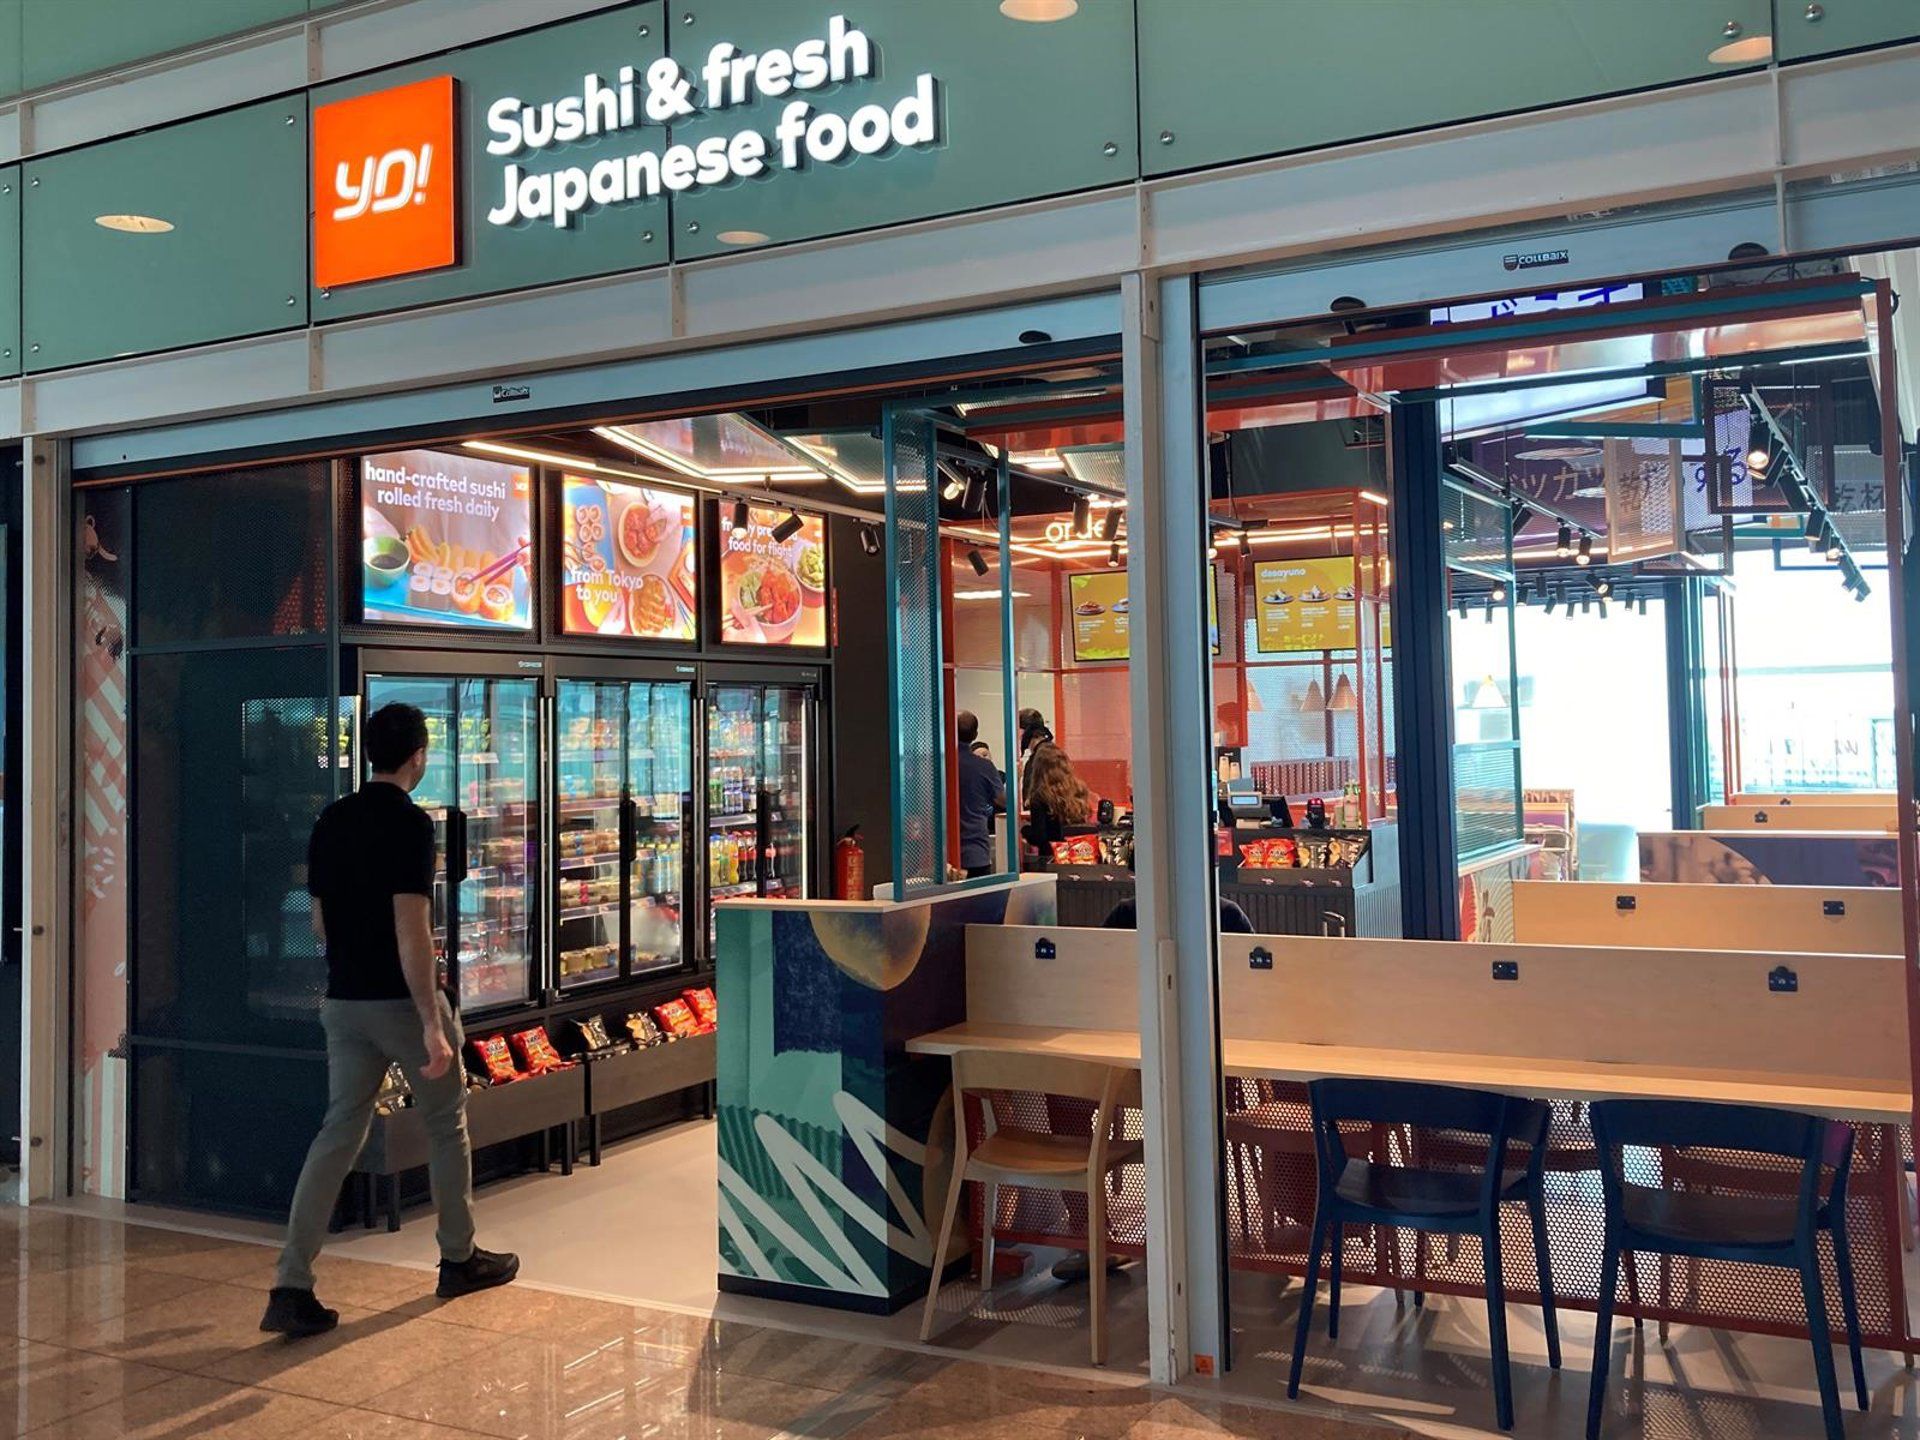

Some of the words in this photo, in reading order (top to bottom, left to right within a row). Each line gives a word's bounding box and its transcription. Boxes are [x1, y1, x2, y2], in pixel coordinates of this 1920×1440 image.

[487, 66, 635, 156] Sushi
[645, 57, 696, 122] &
[702, 15, 871, 109] fresh
[487, 129, 765, 229] Japanese
[777, 73, 935, 170] food
[365, 460, 467, 494] hand-crafted
[470, 481, 506, 500] sushi
[377, 487, 422, 508] rolled
[424, 492, 463, 515] fresh
[466, 499, 500, 523] daily
[728, 537, 751, 552] food
[753, 541, 767, 554] for
[570, 566, 604, 584] from
[607, 570, 644, 591] Tokyo
[576, 585, 591, 600] to
[594, 588, 618, 605] you
